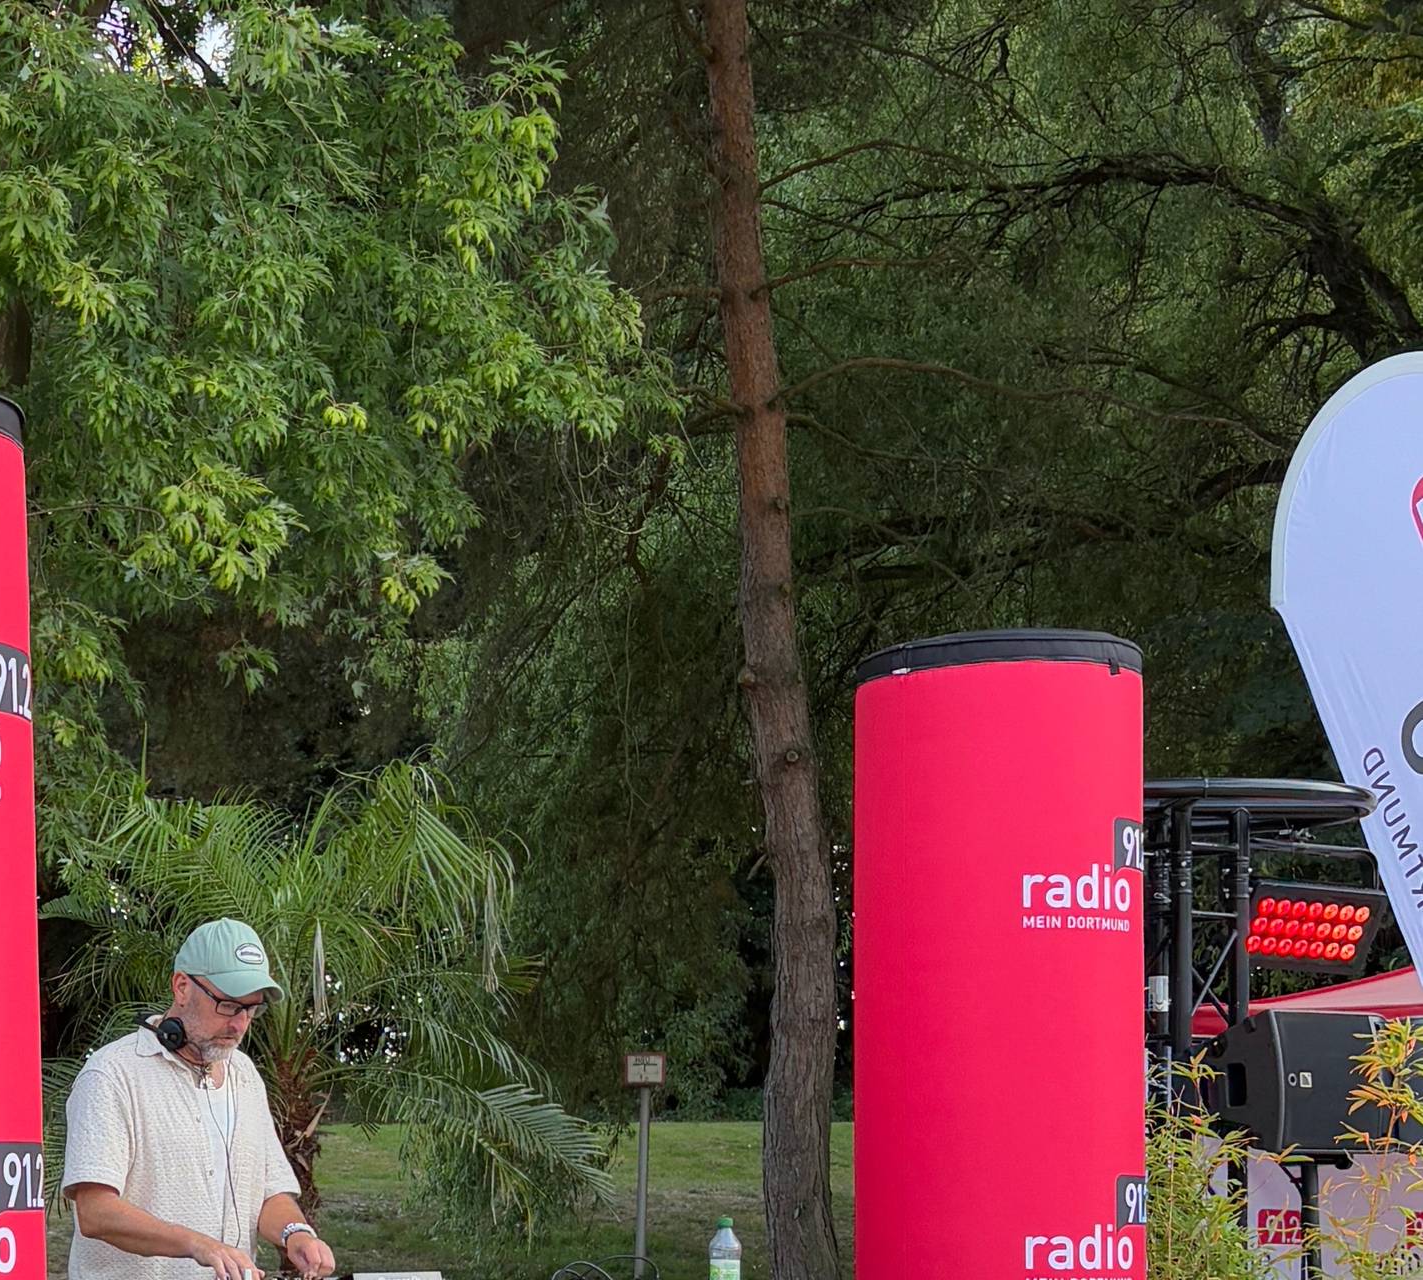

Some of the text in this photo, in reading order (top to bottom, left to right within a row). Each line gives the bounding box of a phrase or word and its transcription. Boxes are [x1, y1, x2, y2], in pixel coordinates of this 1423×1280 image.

[1022, 863, 1131, 912] radio
[1022, 915, 1130, 932] MEIN DORTMUND
[1025, 1224, 1133, 1271] radio
